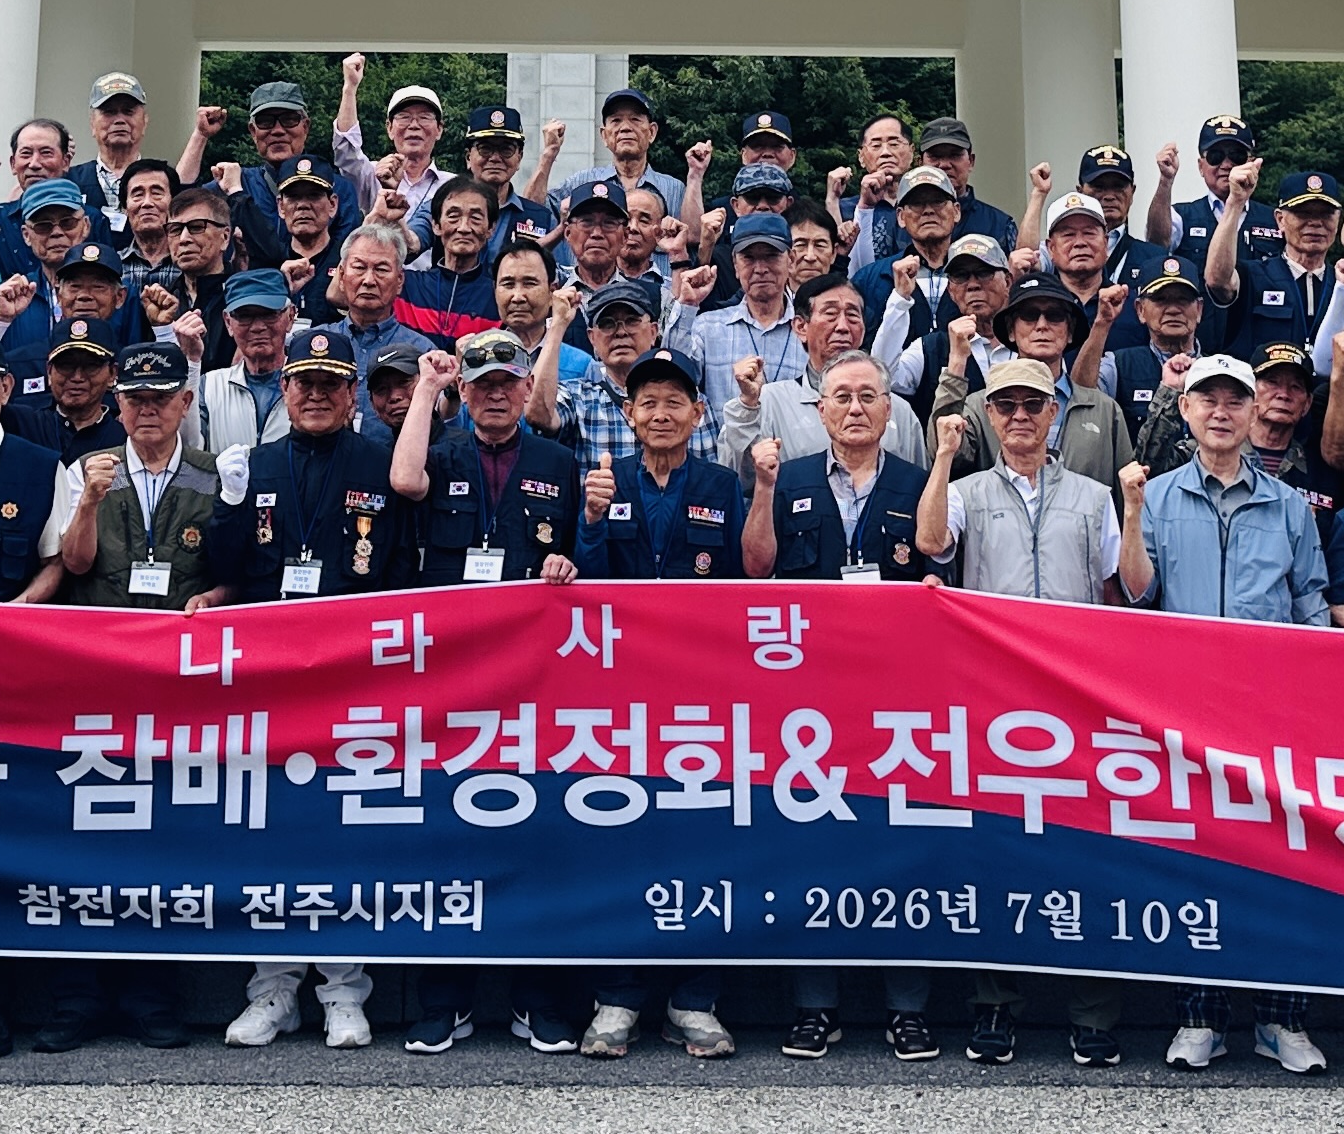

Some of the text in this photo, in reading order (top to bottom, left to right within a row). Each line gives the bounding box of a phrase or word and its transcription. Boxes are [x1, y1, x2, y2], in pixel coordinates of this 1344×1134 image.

[179, 604, 810, 687] 나라사랑
[18, 882, 216, 929] 참전자회
[240, 879, 485, 933] 전주시지회
[644, 879, 733, 934] 일시
[805, 883, 982, 935] 2026년
[1006, 890, 1085, 942] 7월
[1110, 898, 1223, 952] 10일
